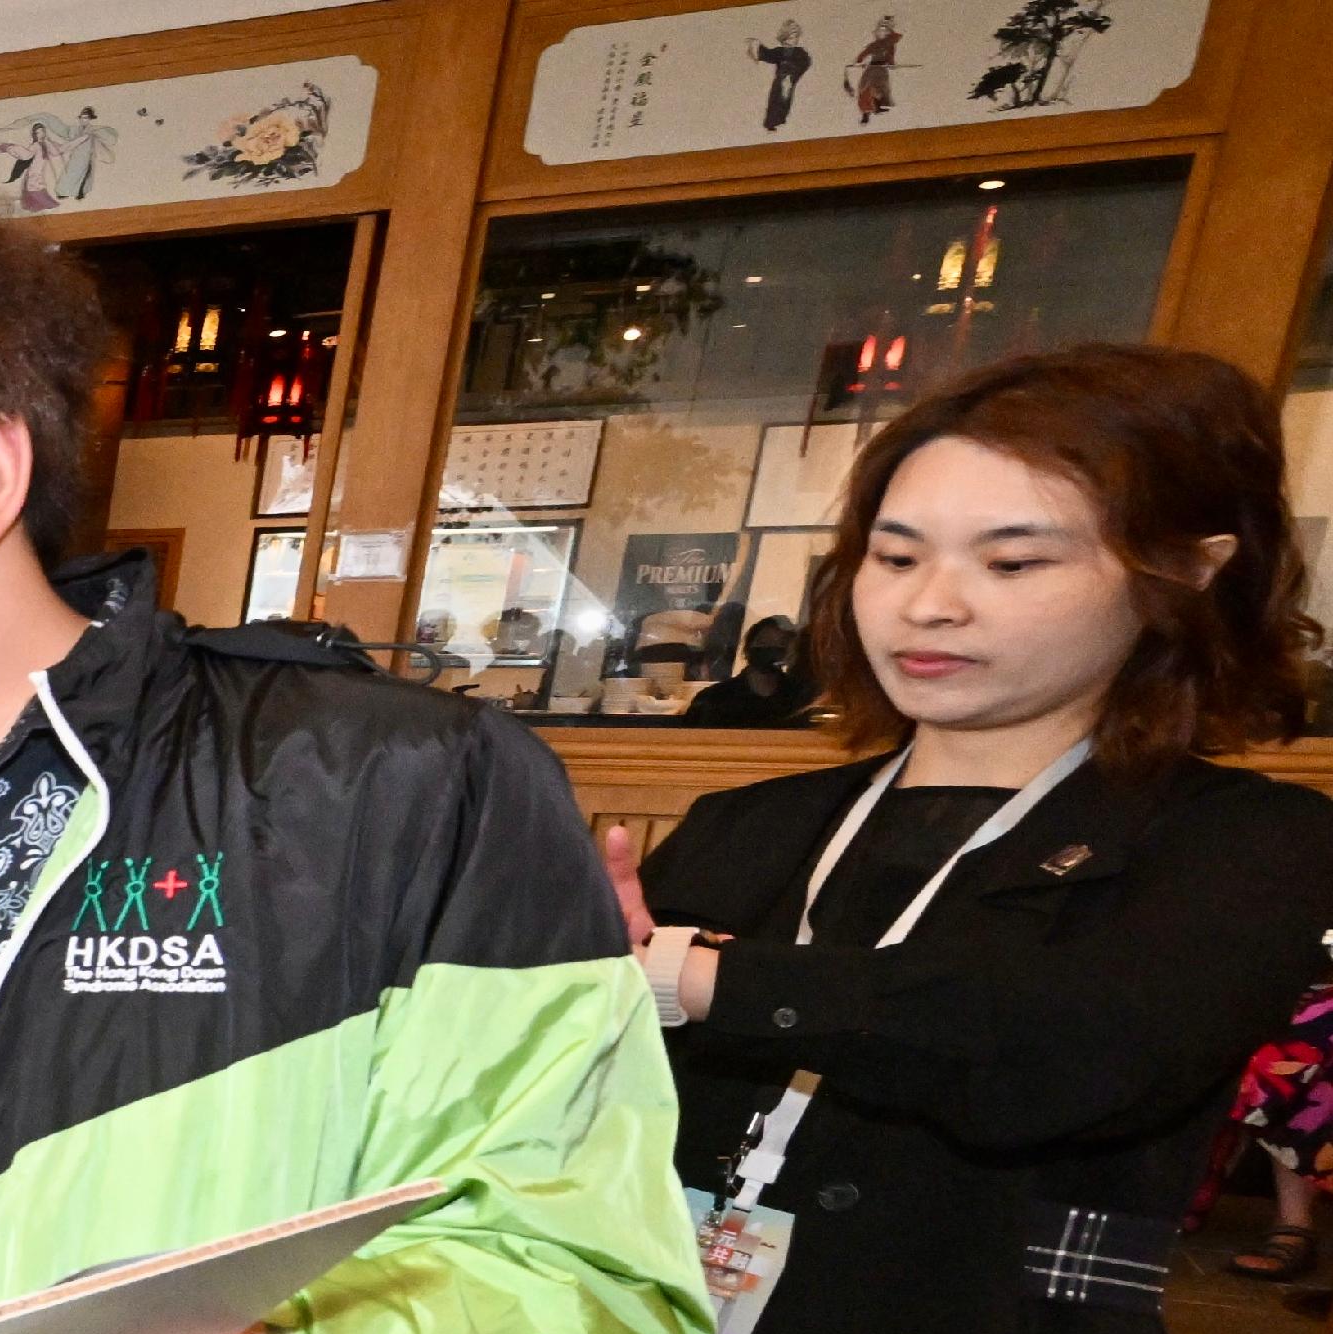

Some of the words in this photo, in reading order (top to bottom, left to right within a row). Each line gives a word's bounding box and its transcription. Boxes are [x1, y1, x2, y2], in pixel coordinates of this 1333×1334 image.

[64, 934, 224, 967] HKDSA
[95, 966, 137, 981] Hong
[139, 966, 179, 982] Kong
[181, 966, 226, 979] Down
